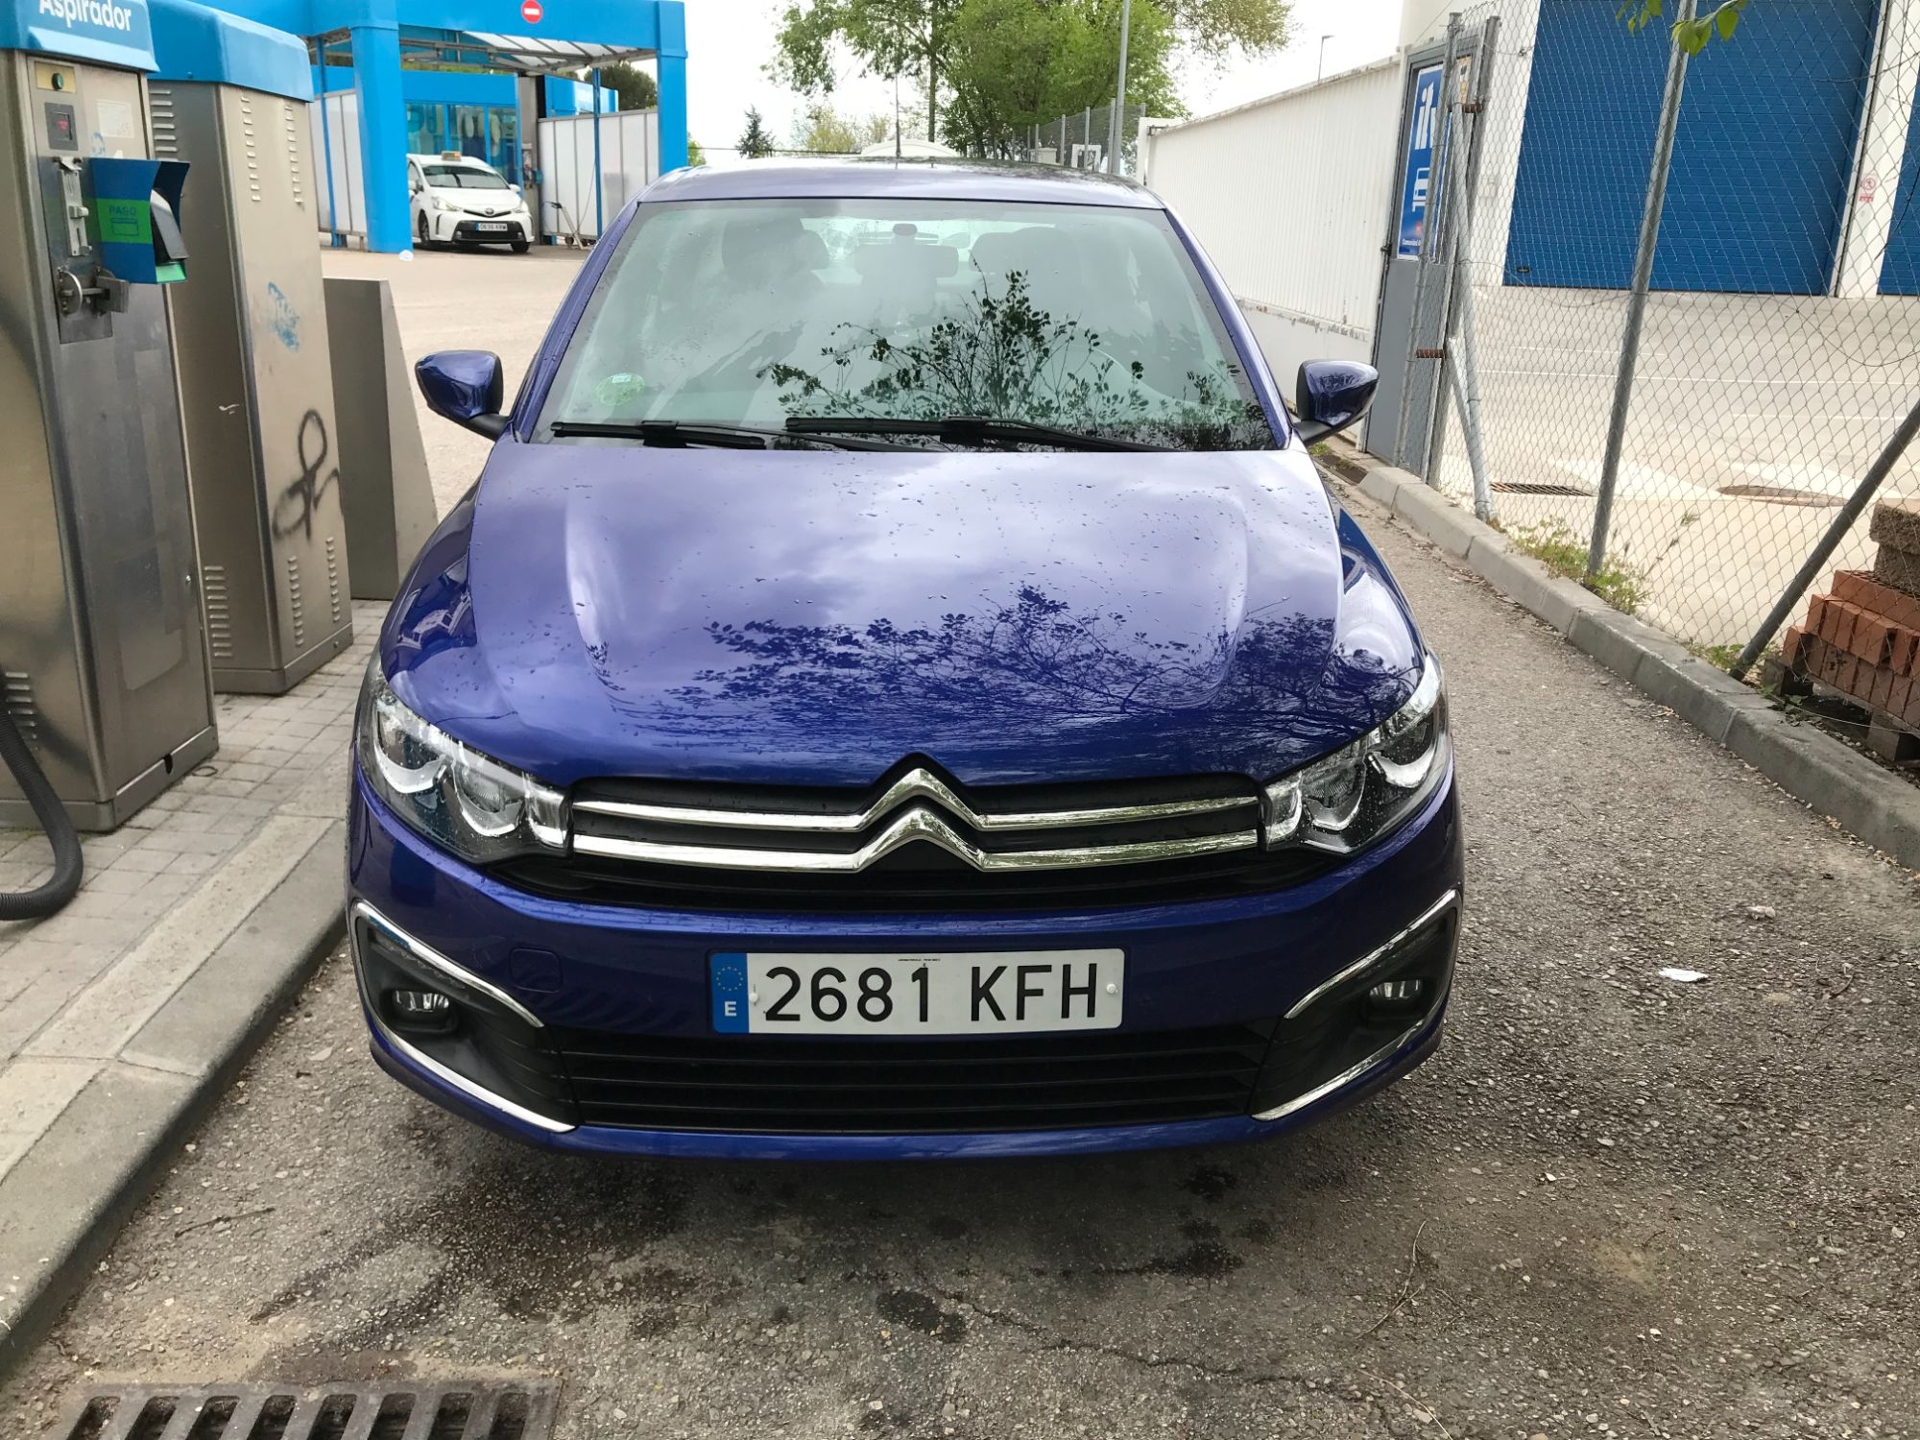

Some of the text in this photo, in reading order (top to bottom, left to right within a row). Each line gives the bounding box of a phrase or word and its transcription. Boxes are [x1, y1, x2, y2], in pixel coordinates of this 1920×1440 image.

[109, 205, 137, 216] PAGO
[765, 963, 1098, 1022] 2681 KFH
[724, 1001, 737, 1017] E
